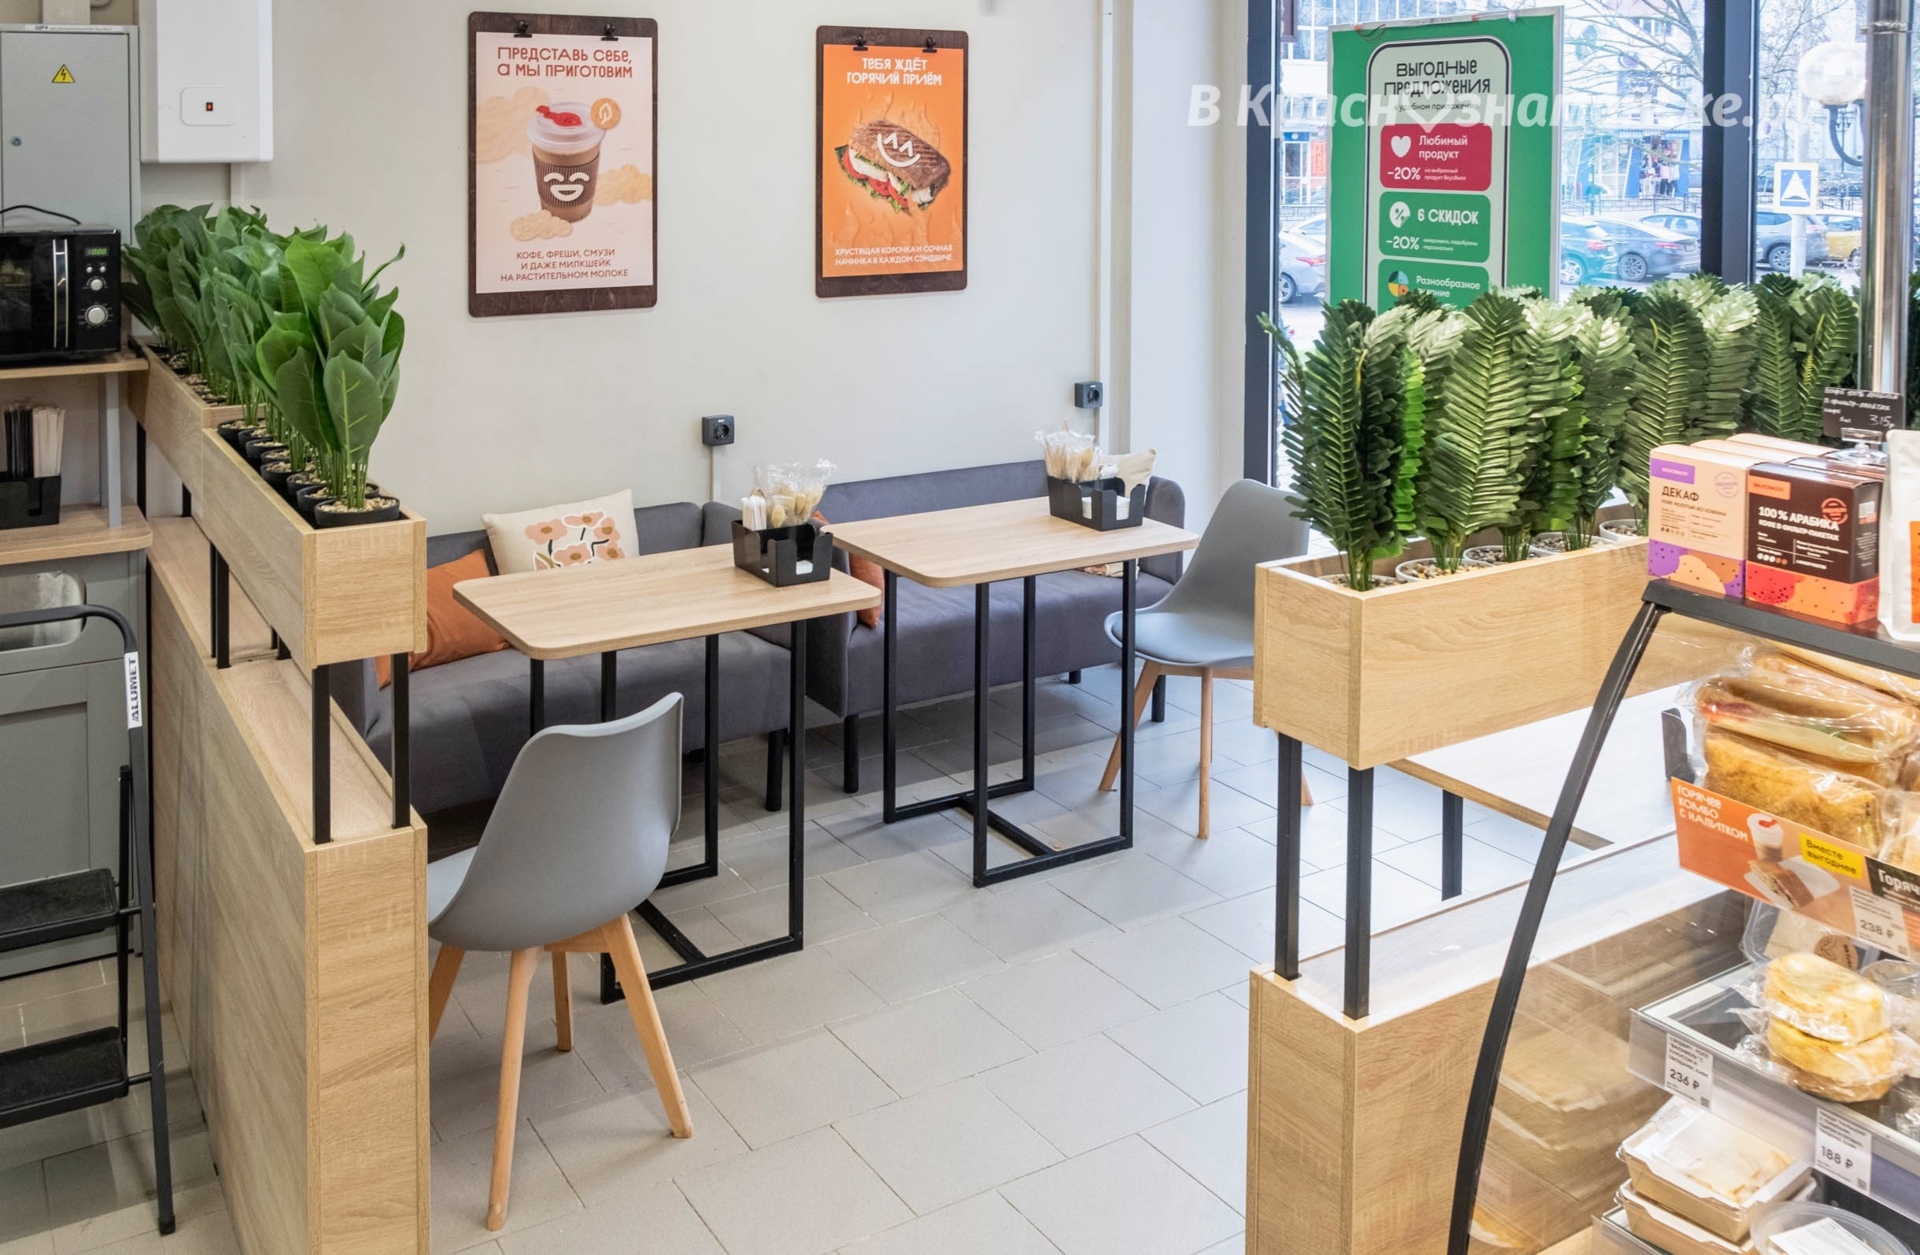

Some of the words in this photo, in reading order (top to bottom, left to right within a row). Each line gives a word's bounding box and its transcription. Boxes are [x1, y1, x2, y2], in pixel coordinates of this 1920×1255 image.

[497, 47, 588, 62] ПРЕДСТАВЬ
[515, 64, 540, 76] МЫ
[545, 65, 632, 78] ПРИГОТОВИМ
[862, 57, 891, 70] ТЕБЯ
[895, 57, 928, 72] ЖДЁТ
[1396, 59, 1477, 78] ВЫГОДНЫЕ
[846, 71, 900, 85] ГОРЯЧИЙ
[903, 72, 942, 86] ПРИЁМ
[1384, 79, 1491, 98] ПРЕДЛОЖЕНИЯ
[1419, 135, 1468, 146] Любимый
[1419, 151, 1460, 161] продукт
[1387, 167, 1421, 181] -20%
[1417, 208, 1425, 222] 6
[1428, 209, 1479, 226] СКИДОК
[835, 247, 880, 256] ХРУСТЯЩАЯ
[881, 246, 915, 254] КОРОЧКА
[923, 244, 953, 252] СОЧНАЯ
[1386, 235, 1420, 251] -20%
[516, 251, 544, 259] КОФЕ,
[546, 250, 582, 259] ФРЕШИ,
[583, 249, 615, 257] СМУЗИ
[835, 257, 872, 265] НАЧИНКА
[879, 255, 913, 264] КАЖДОМ
[530, 261, 556, 270] ДАЖЕ
[559, 258, 611, 268] МИЛКШЕЙК
[516, 270, 589, 281] РАСТИТЕЛЬНОМ
[590, 269, 628, 277] МОЛОКЕ
[1416, 275, 1480, 290] Разнообразное
[1661, 486, 1699, 501] ДЕКАФ
[1758, 519, 1776, 528] КОФЕ
[1789, 512, 1840, 531] АРАБИКА
[128, 658, 139, 722] ALUMET
[1677, 785, 1722, 809] ГОРЯЧЕЕ
[1678, 797, 1719, 819] КОМБО
[1679, 808, 1686, 818] С
[1688, 811, 1749, 842] НАПИТКОМ
[1806, 839, 1844, 860] Вместе
[1807, 850, 1857, 875] выгоднее
[1860, 919, 1883, 936] 238
[1670, 1068, 1689, 1086] 236
[1821, 1146, 1841, 1164] 188
